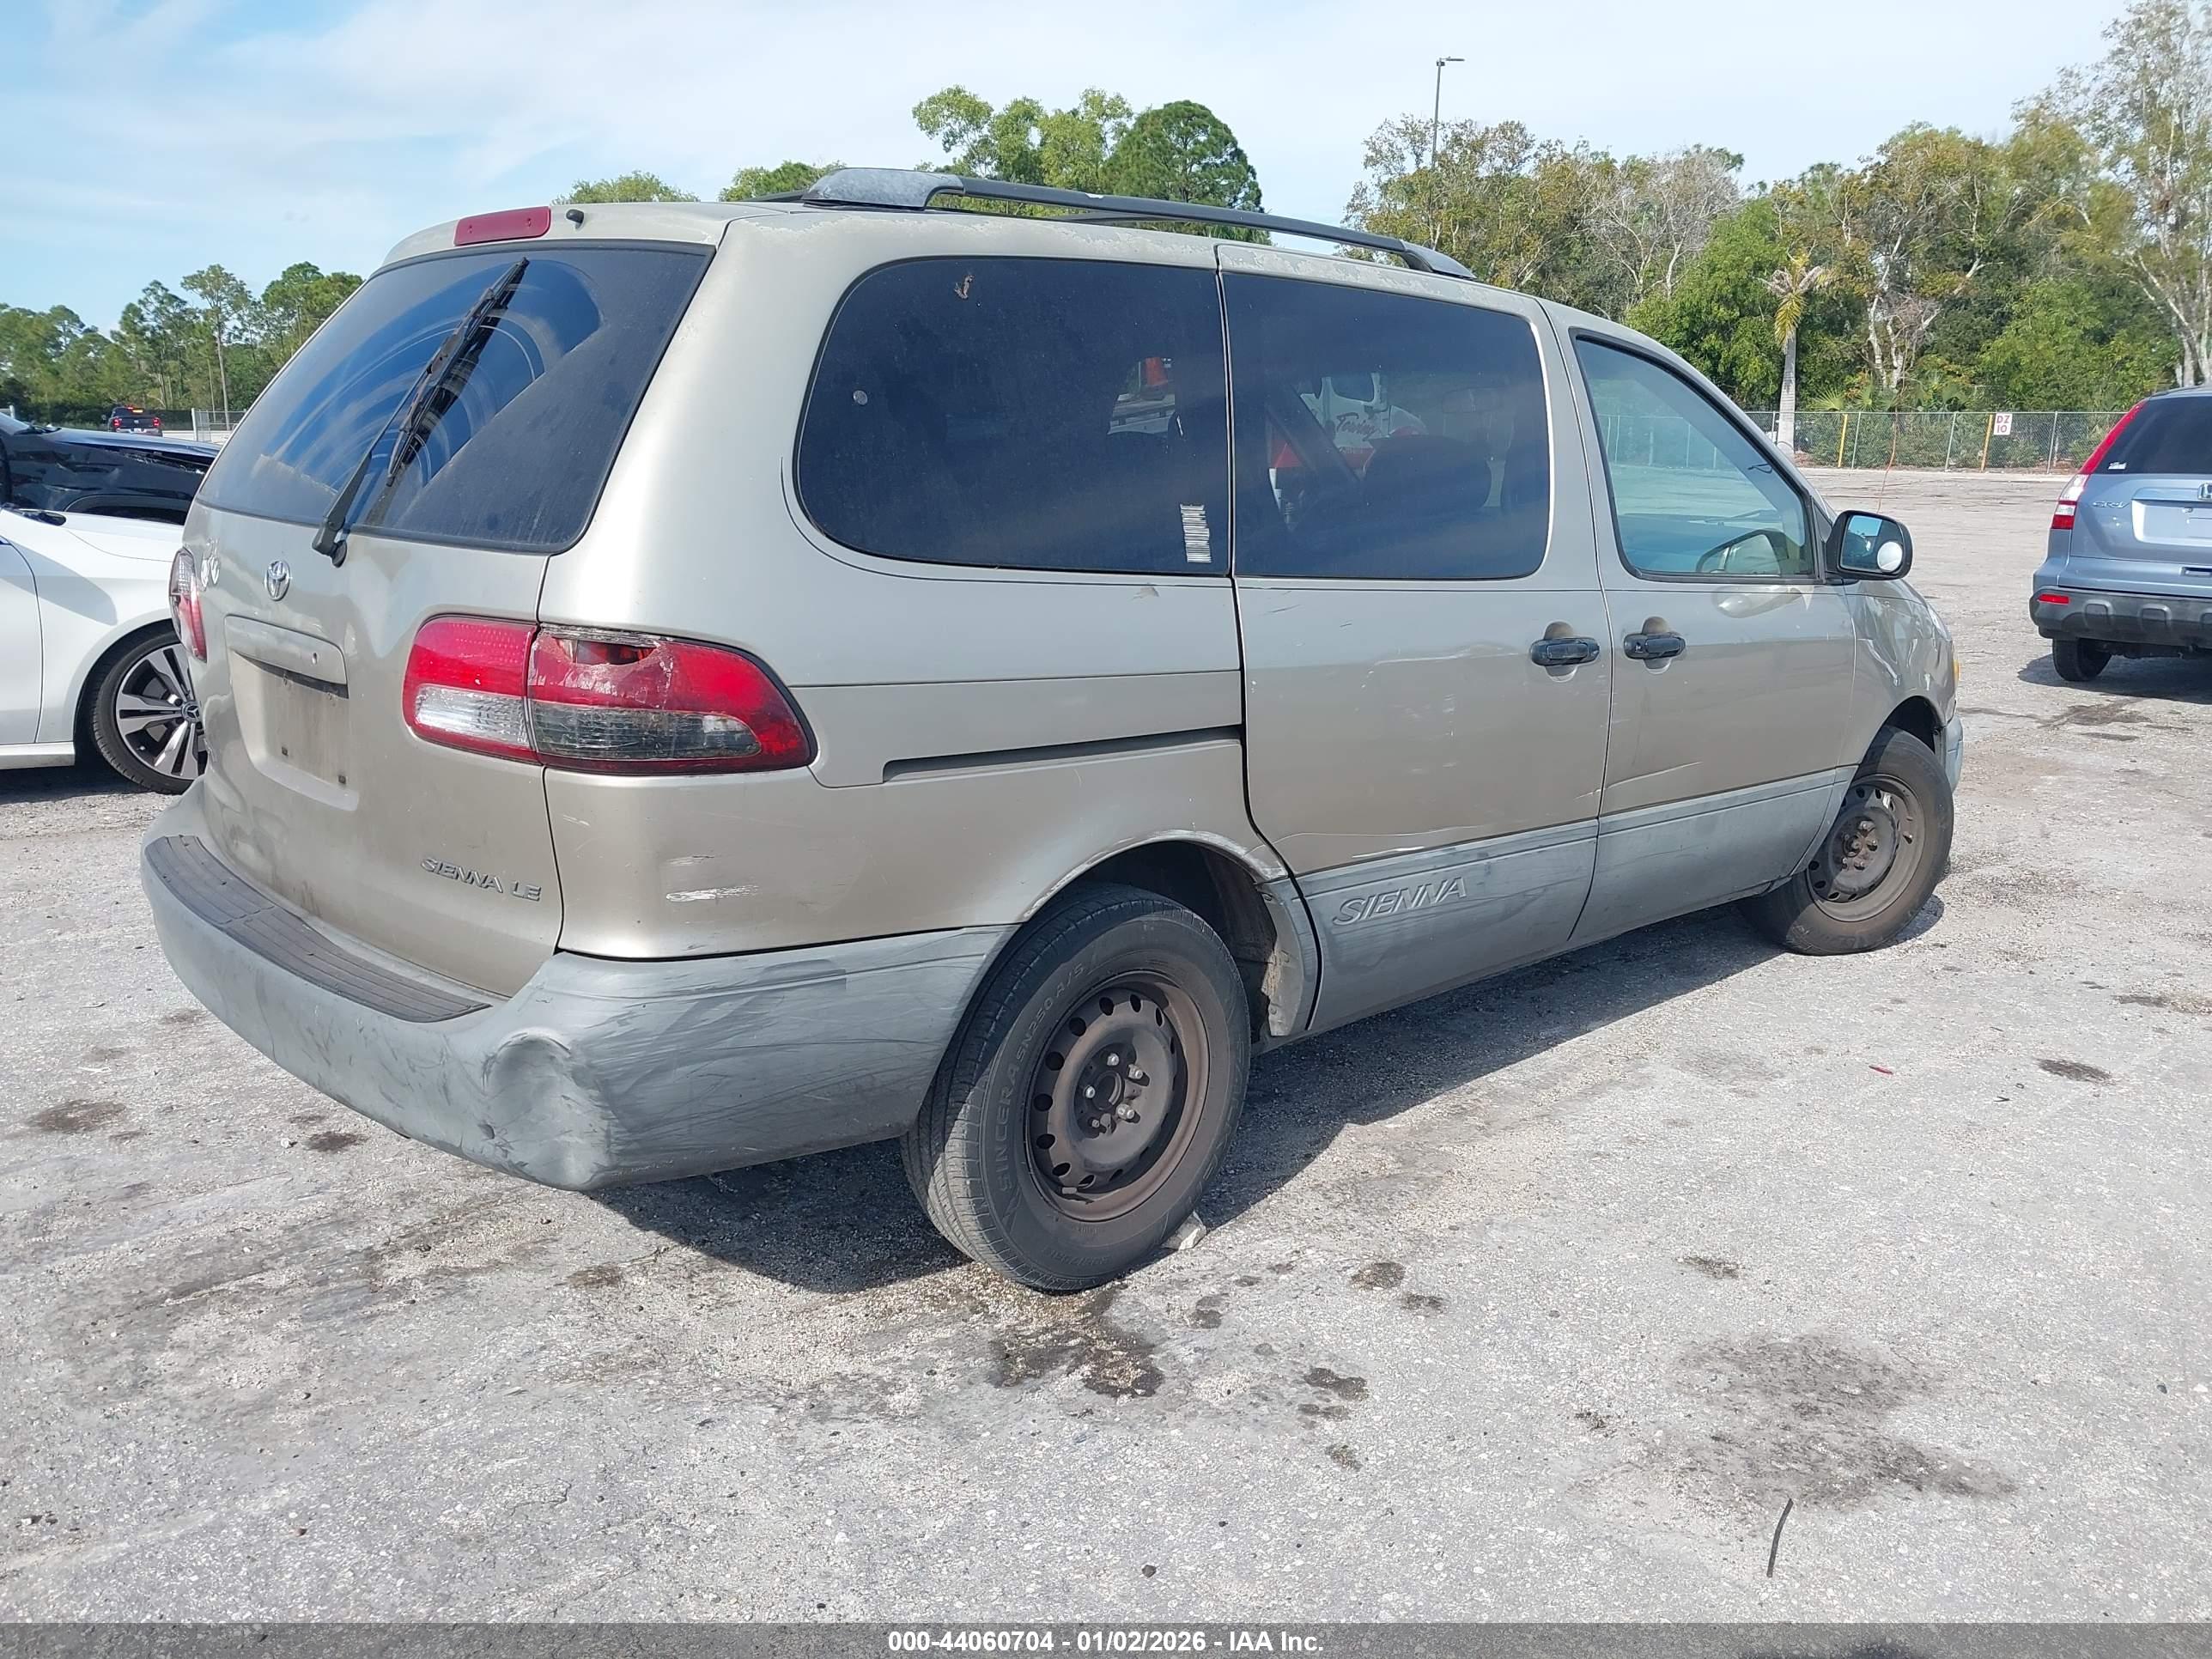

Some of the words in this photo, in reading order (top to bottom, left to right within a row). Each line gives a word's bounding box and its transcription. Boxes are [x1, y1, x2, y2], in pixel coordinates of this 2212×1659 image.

[420, 857, 504, 894] SIENNA
[512, 881, 542, 902] LE
[1332, 877, 1468, 926] SIENNA
[994, 1062, 1021, 1192] SINCERA
